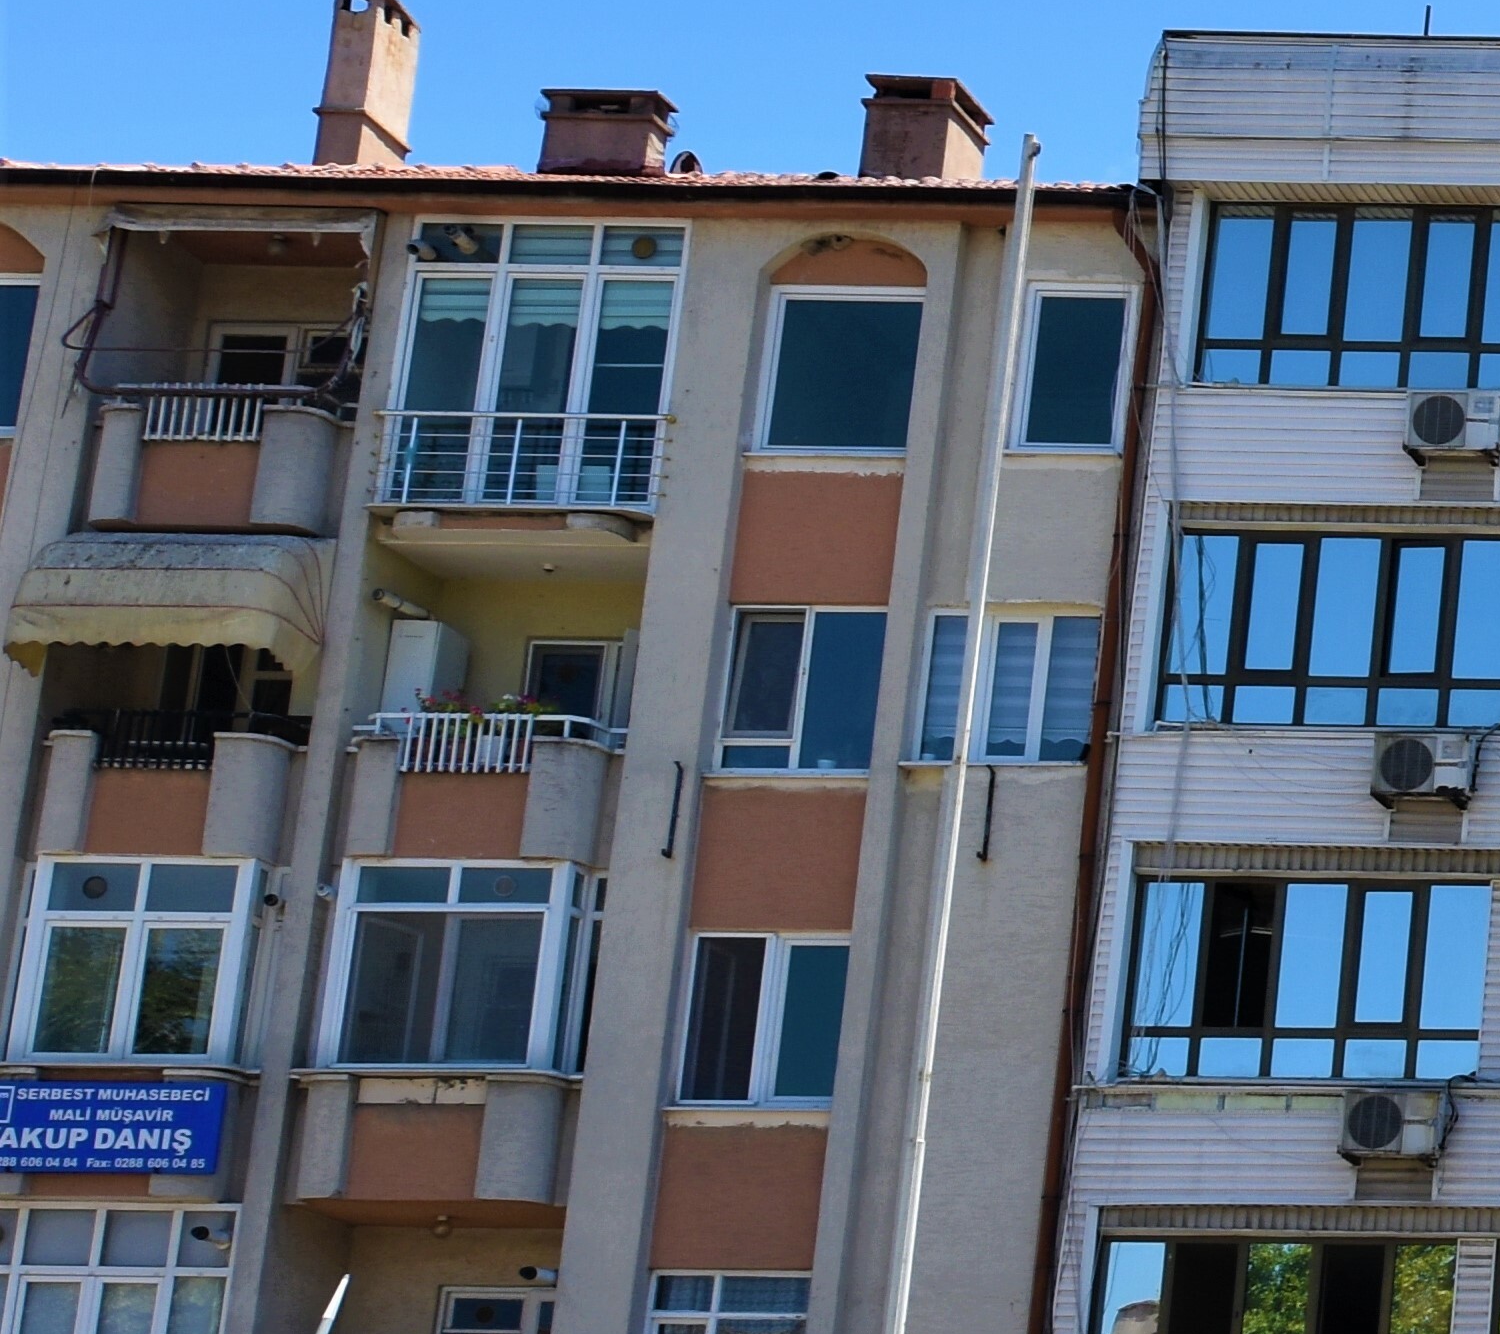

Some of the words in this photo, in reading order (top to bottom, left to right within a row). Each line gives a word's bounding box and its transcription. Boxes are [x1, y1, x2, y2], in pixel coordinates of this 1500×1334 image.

[16, 1088, 95, 1100] SERBEST
[97, 1087, 209, 1101] MUHASEBECİ
[49, 1107, 91, 1121] MALİ
[96, 1107, 173, 1124] MÜŞAVİR
[0, 1127, 88, 1149] AKUP
[93, 1128, 193, 1155] DANIŞ
[20, 1156, 43, 1167] 606
[45, 1157, 60, 1167] 04
[62, 1157, 78, 1167] 84
[86, 1157, 111, 1168] Fax:
[114, 1157, 143, 1168] 0288
[147, 1157, 169, 1168] 606
[172, 1157, 187, 1168] 04
[190, 1157, 205, 1168] 85
